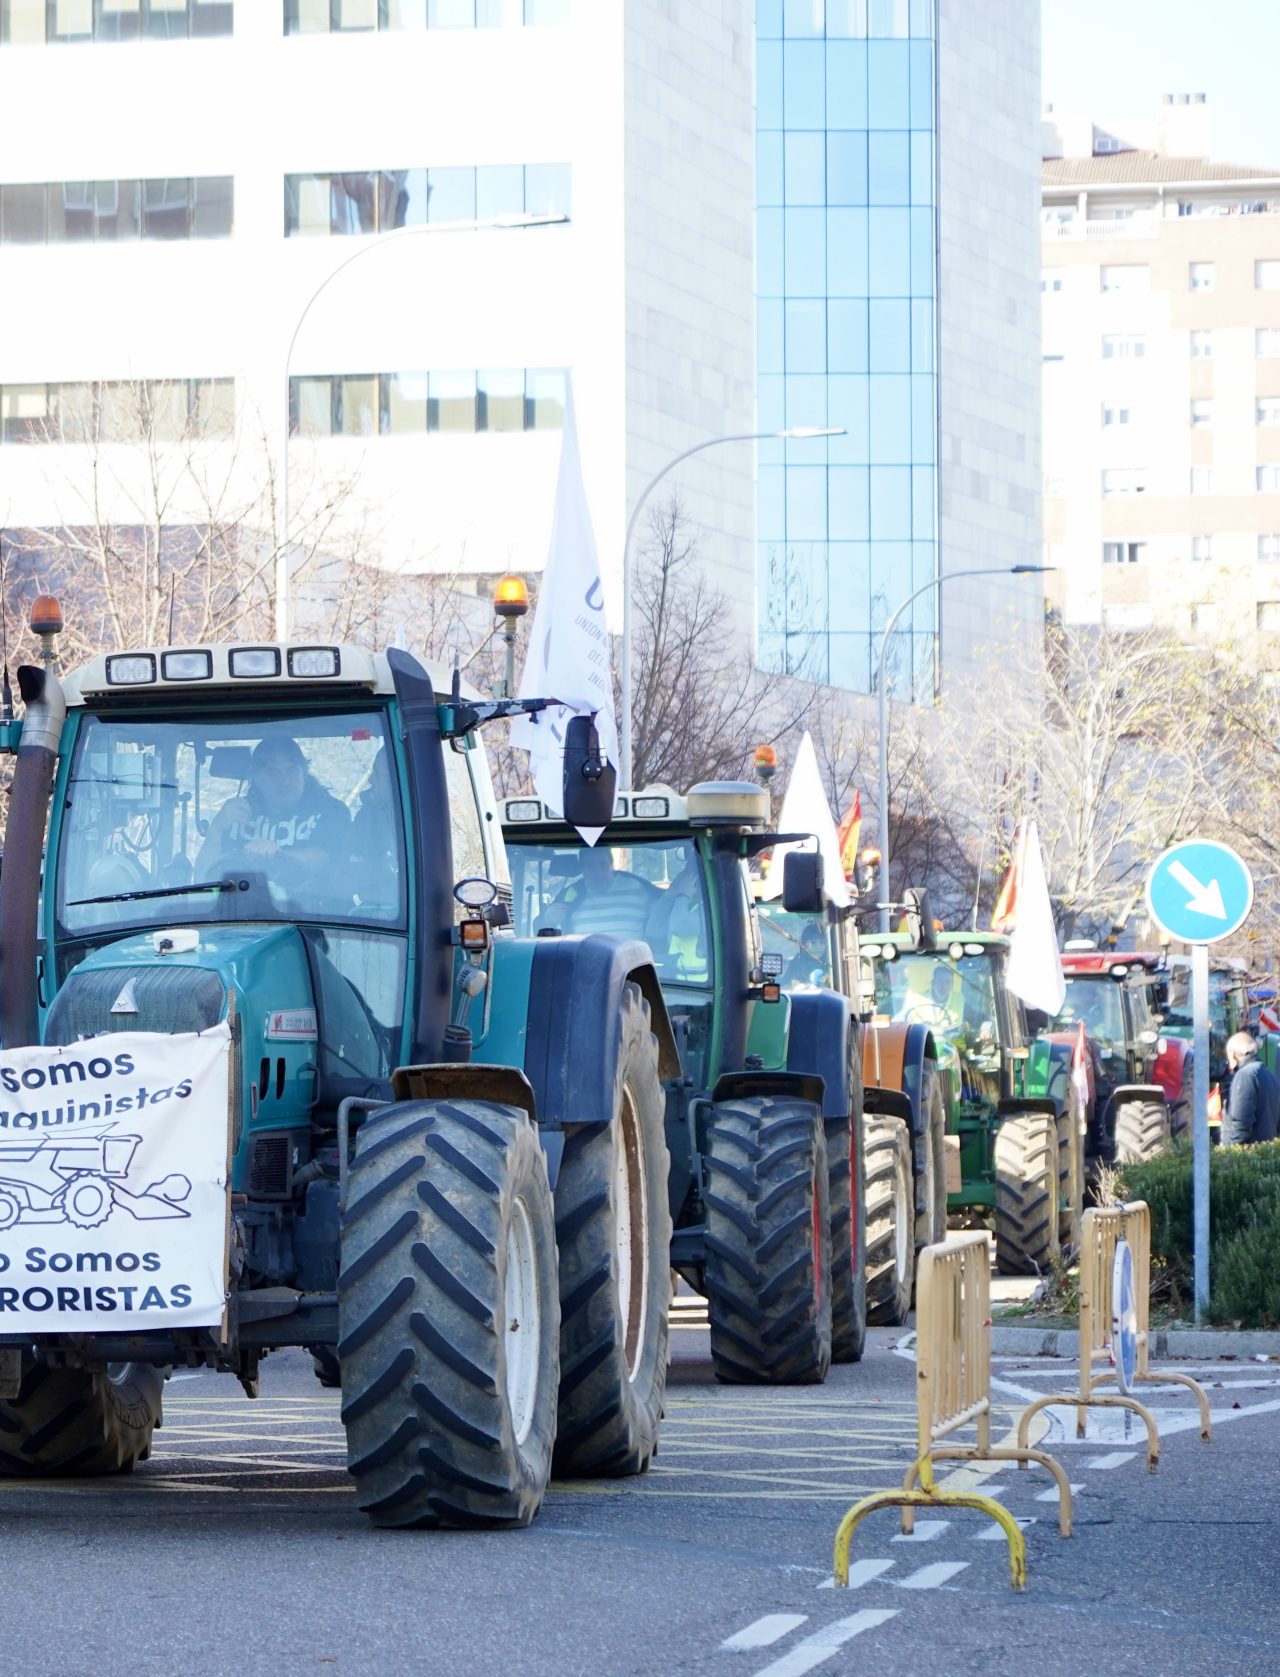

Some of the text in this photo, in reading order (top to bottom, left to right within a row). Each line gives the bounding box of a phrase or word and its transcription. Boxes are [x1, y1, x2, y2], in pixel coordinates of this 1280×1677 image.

[587, 649, 604, 667] DEL
[0, 1053, 135, 1093] Somos
[25, 1247, 161, 1273] Somos
